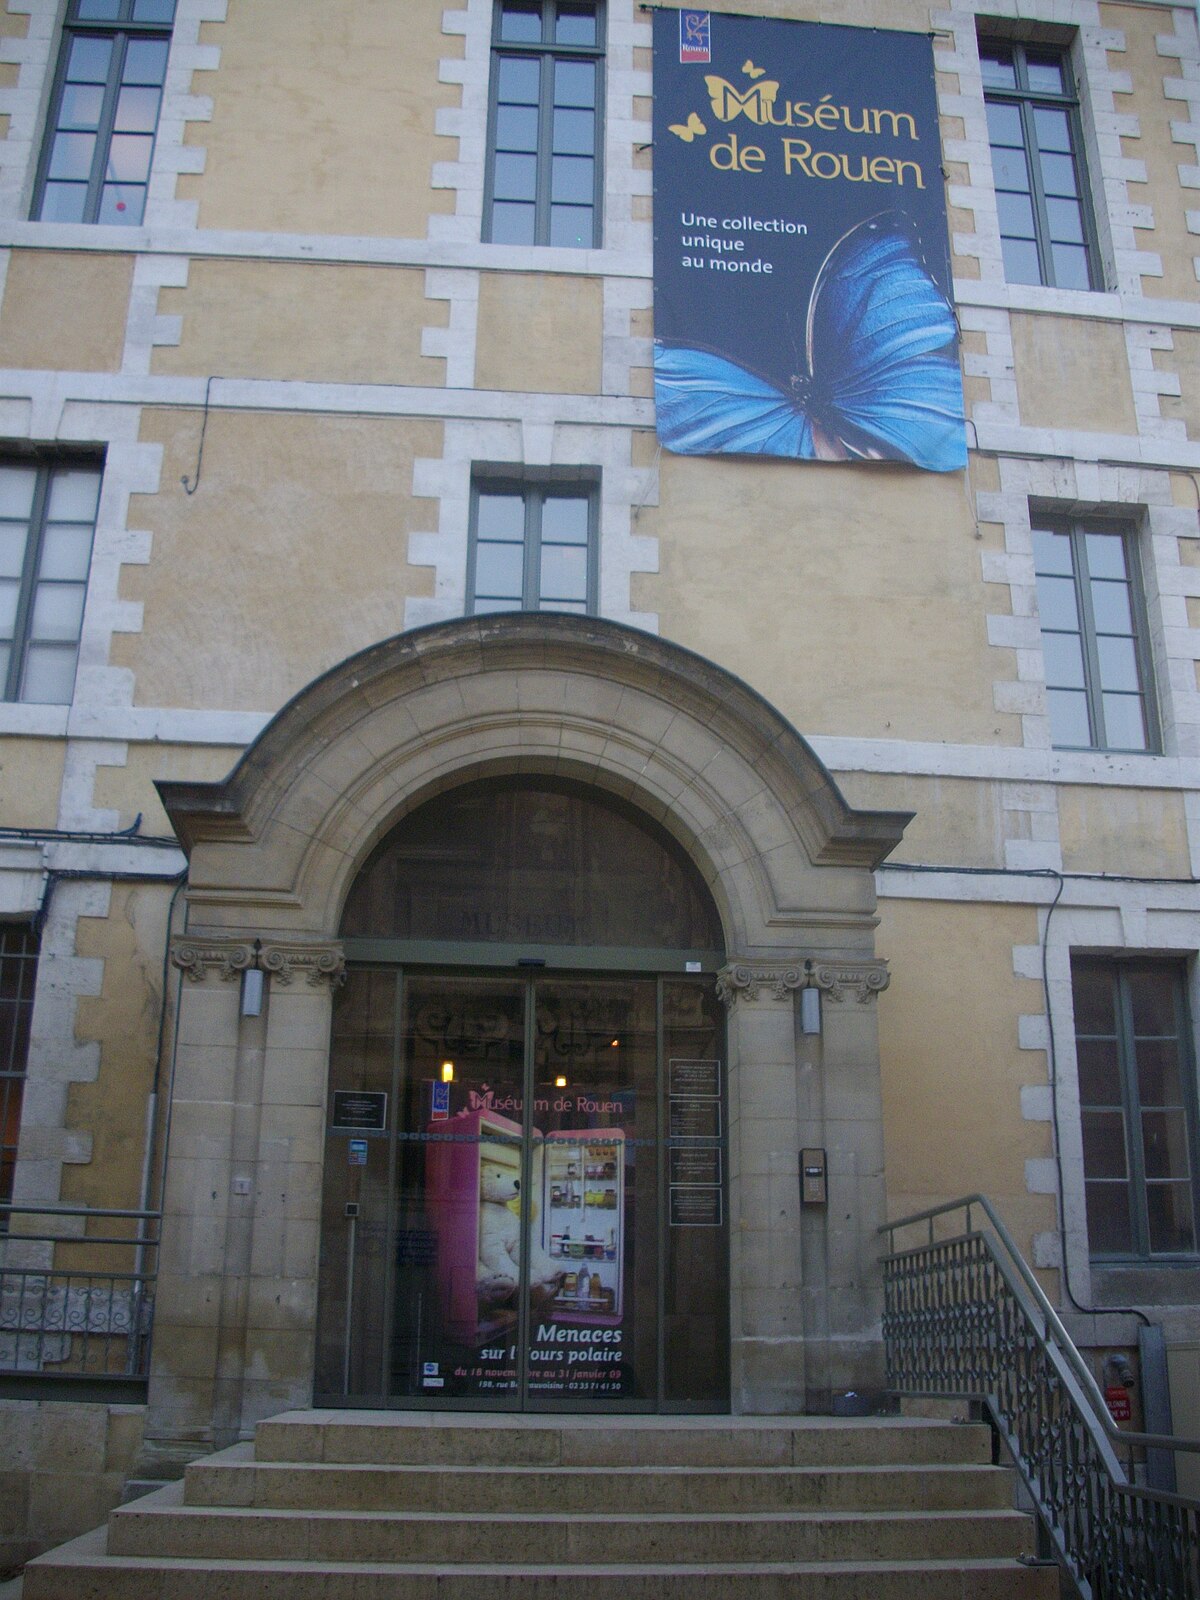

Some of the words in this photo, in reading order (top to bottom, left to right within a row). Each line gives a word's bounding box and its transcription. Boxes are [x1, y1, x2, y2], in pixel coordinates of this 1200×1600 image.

[682, 43, 709, 52] Rouen
[704, 75, 919, 140] Muséum
[709, 134, 766, 173] de
[781, 137, 926, 189] Rouen
[681, 212, 718, 230] Une
[722, 215, 808, 235] collection
[682, 234, 745, 253] unique
[682, 255, 704, 268] au
[710, 257, 773, 274] monde
[553, 1097, 573, 1112] de
[577, 1096, 623, 1113] Rouen
[536, 1324, 623, 1343] Menaces
[480, 1348, 505, 1360] sur
[567, 1346, 623, 1364] polaire
[454, 1367, 467, 1377] du
[543, 1370, 556, 1378] au
[558, 1368, 569, 1378] 31
[573, 1368, 607, 1380] janvier
